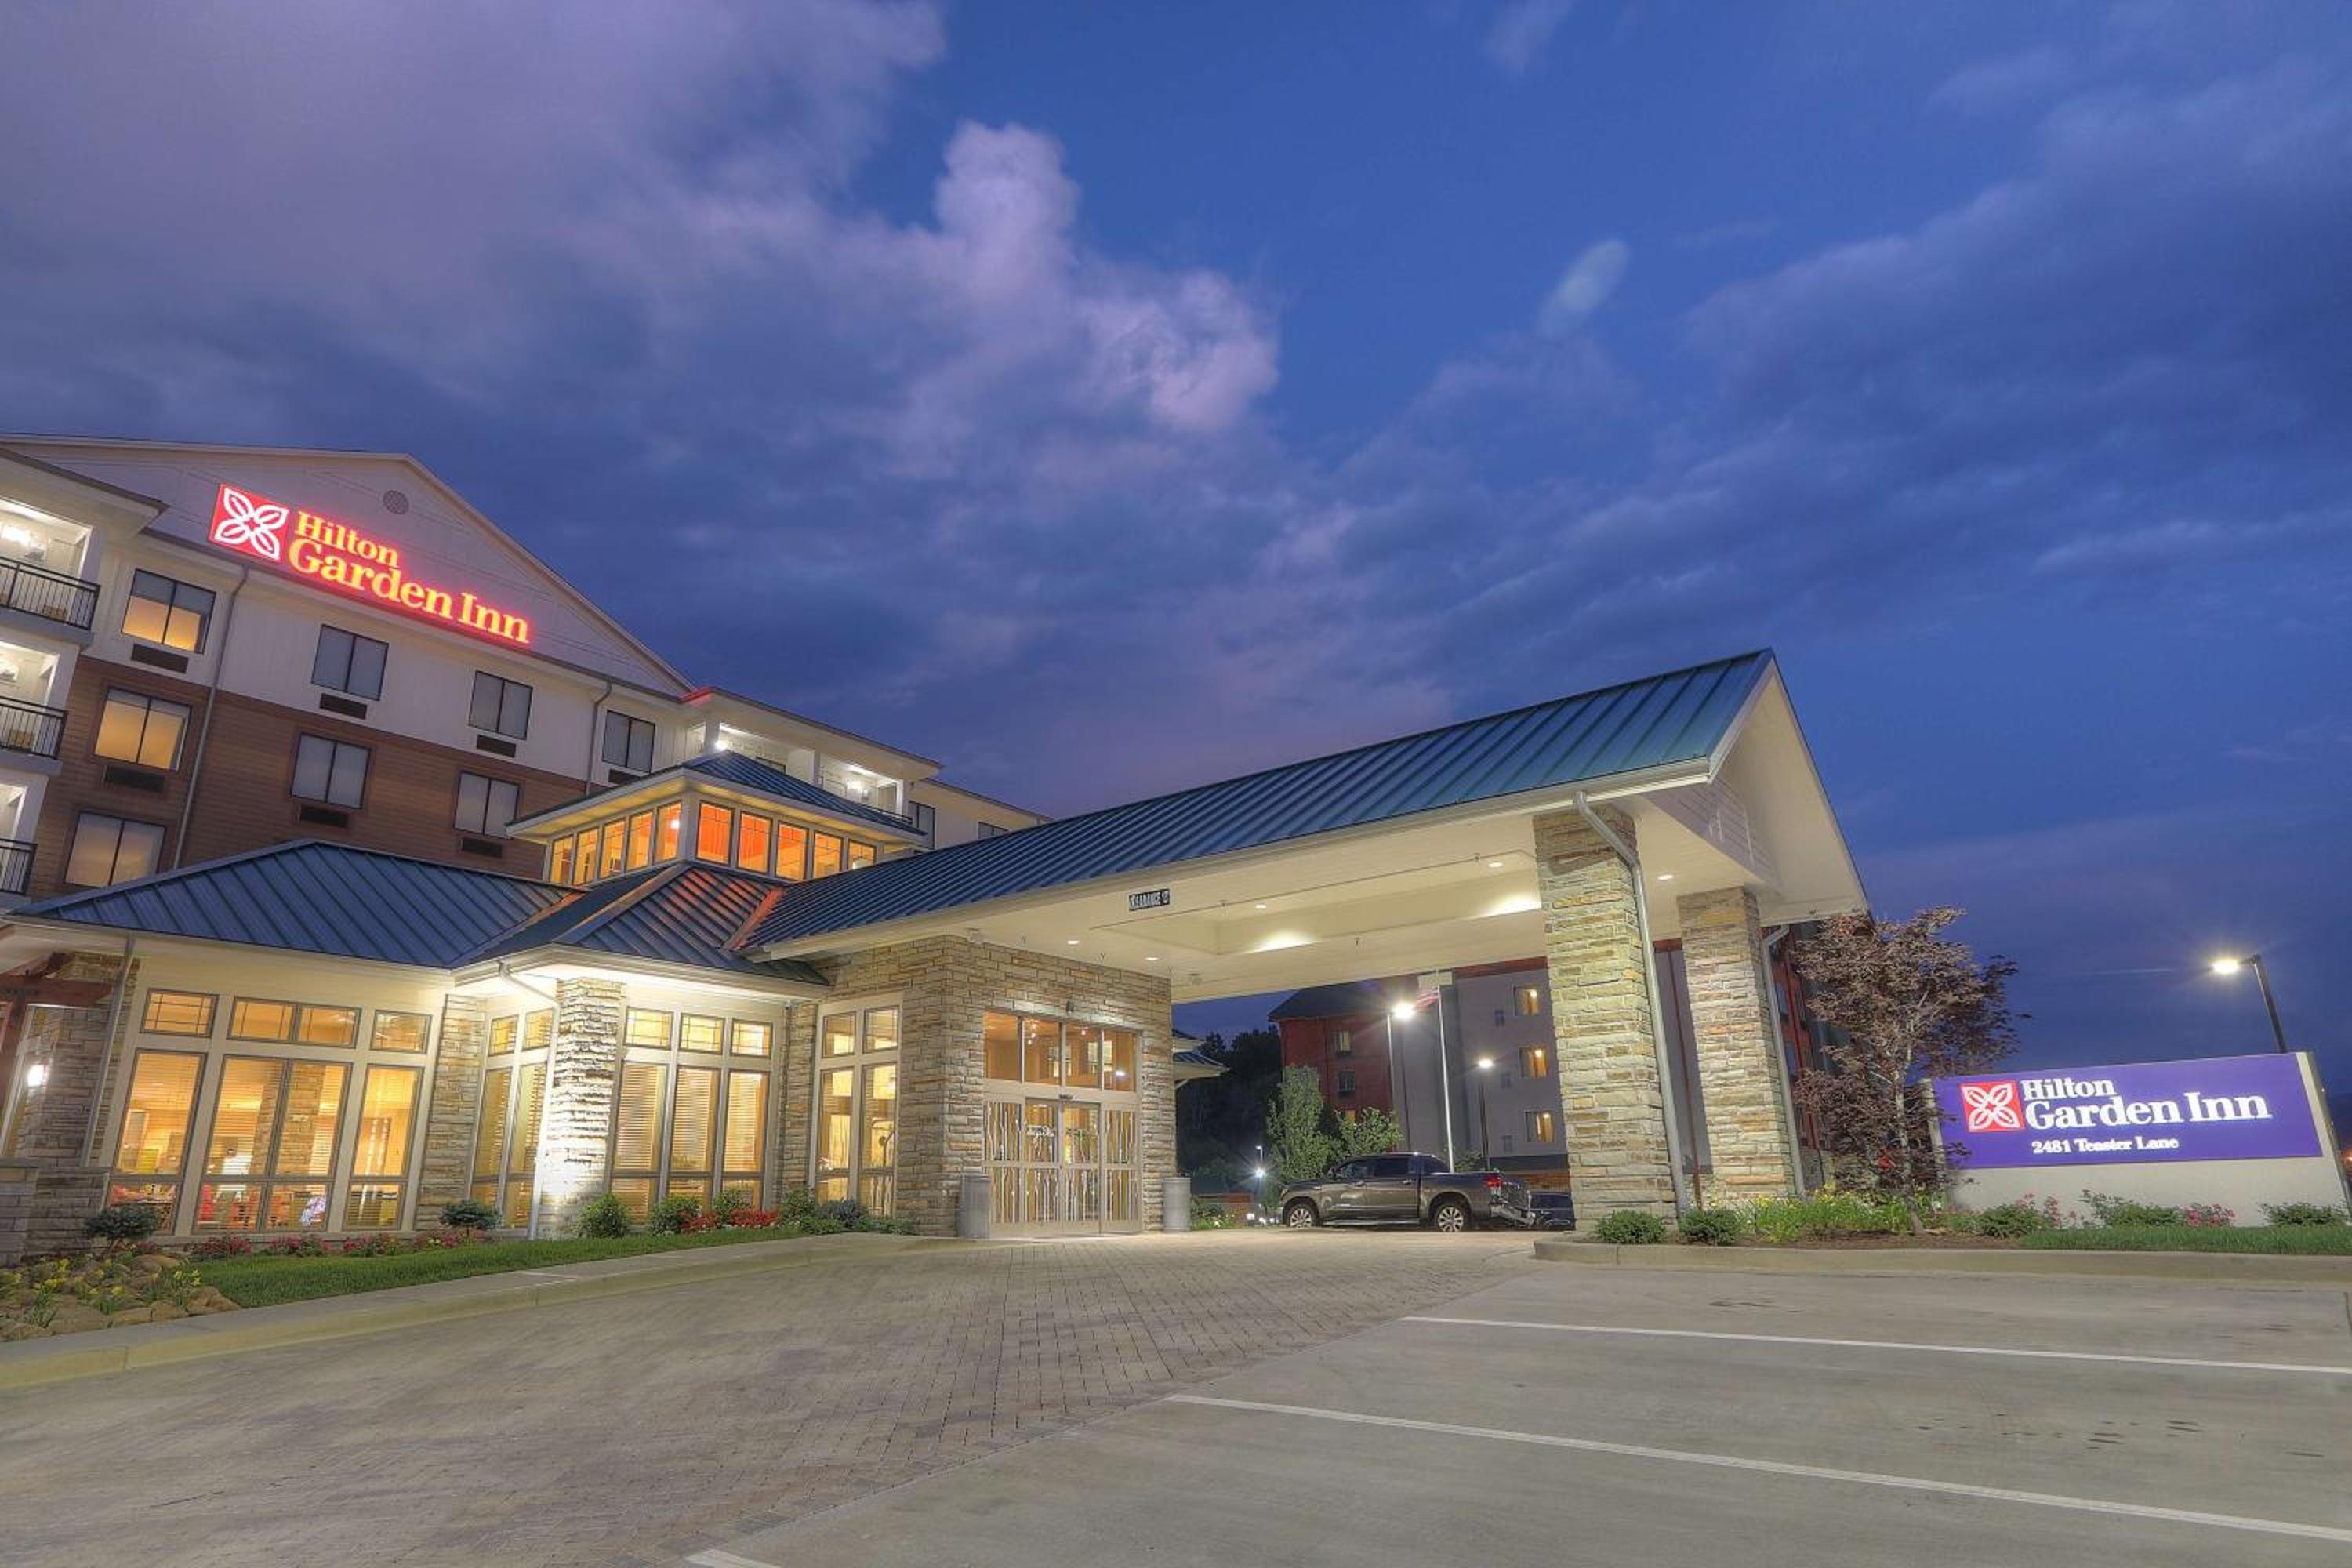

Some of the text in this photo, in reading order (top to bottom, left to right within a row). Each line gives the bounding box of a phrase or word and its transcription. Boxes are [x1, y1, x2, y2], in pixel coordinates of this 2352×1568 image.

[295, 511, 400, 568] Hilton
[289, 538, 531, 644] Garden Inn
[2021, 1077, 2116, 1101] Hilton
[2024, 1091, 2272, 1131] Garden Inn
[2031, 1139, 2071, 1154] 2481
[2135, 1135, 2179, 1150] Lane
